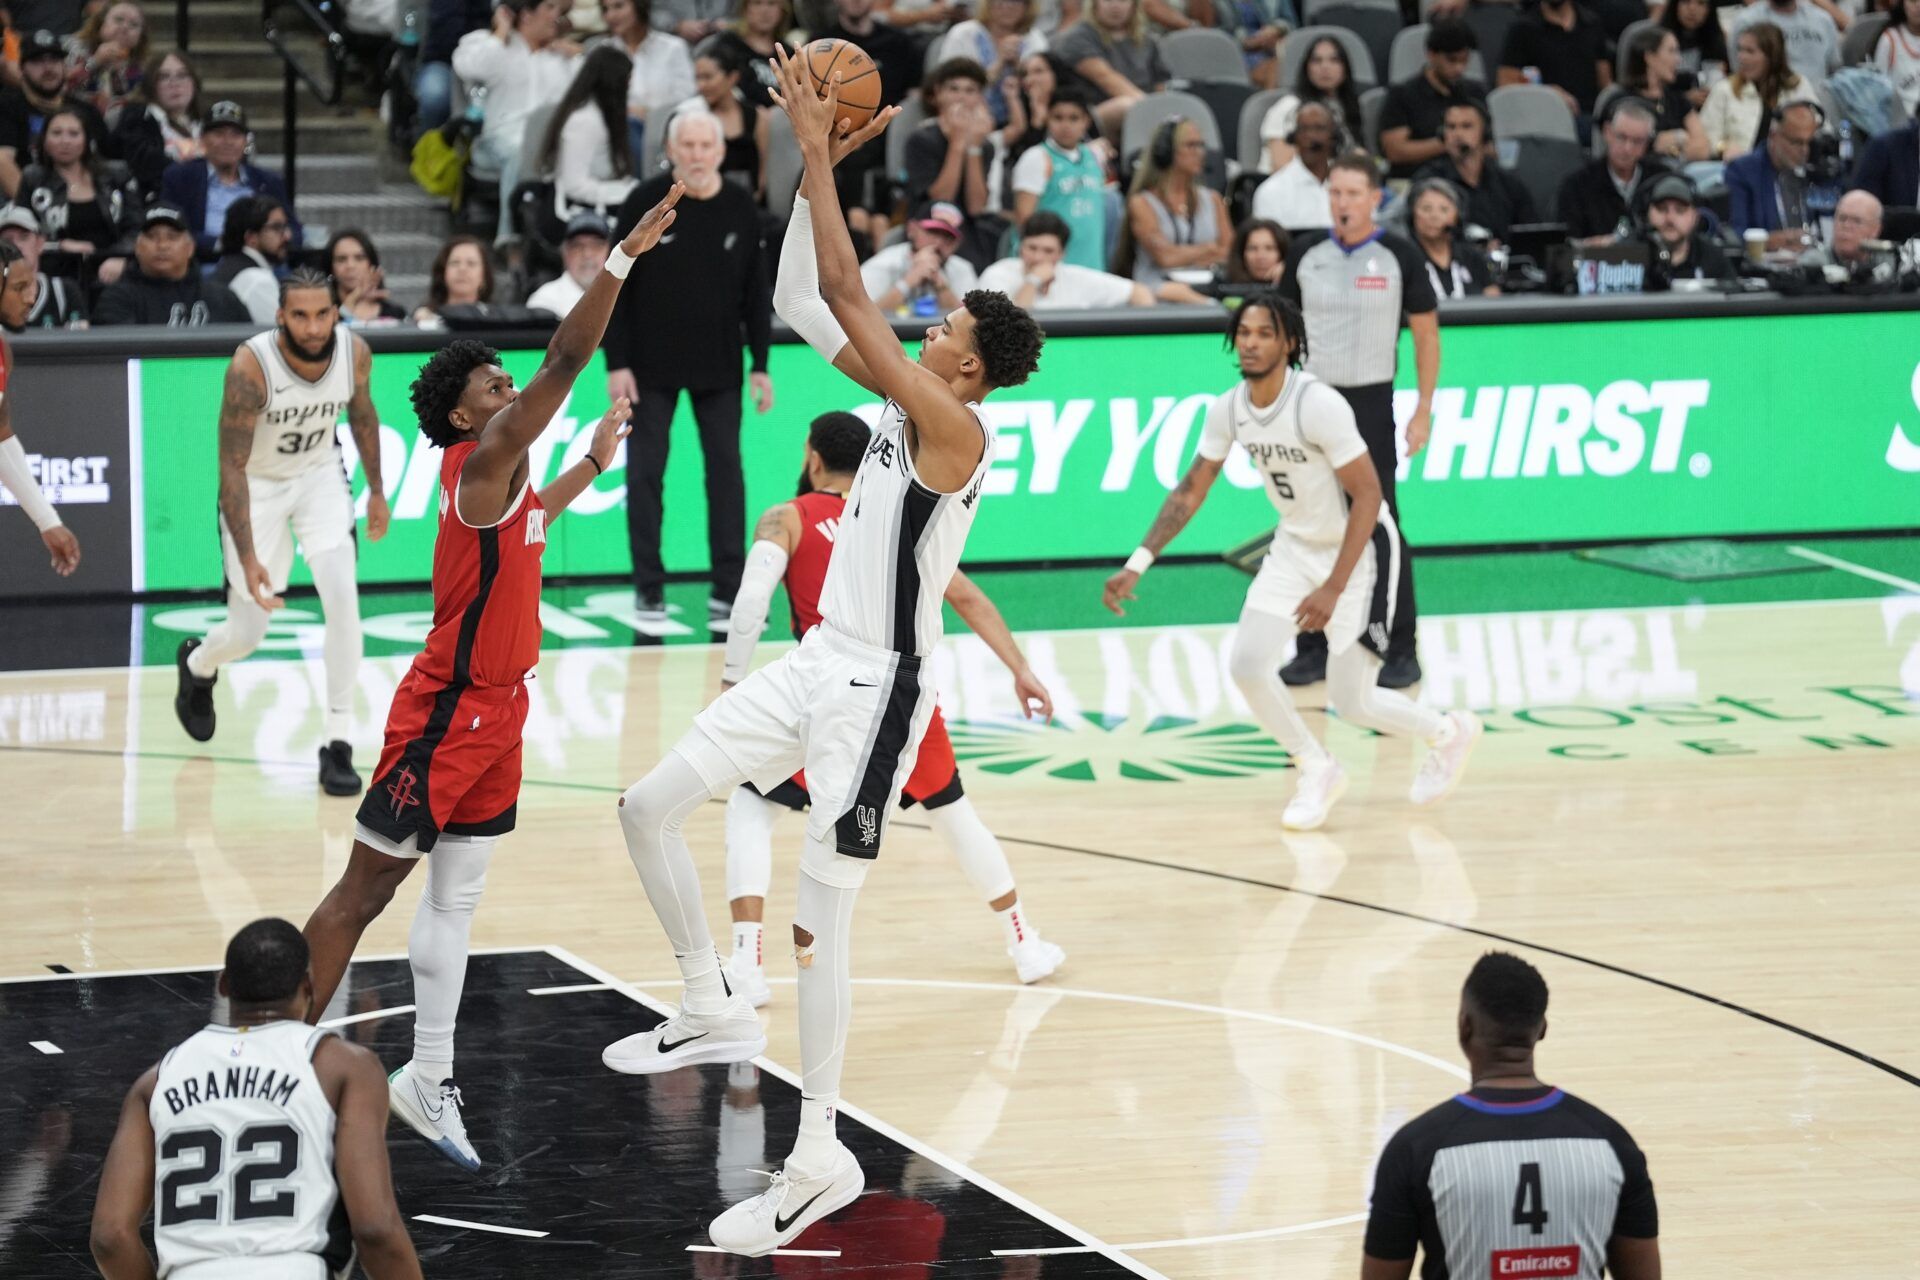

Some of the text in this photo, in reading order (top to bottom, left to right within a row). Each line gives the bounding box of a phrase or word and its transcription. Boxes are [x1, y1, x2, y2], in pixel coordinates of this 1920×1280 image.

[276, 427, 326, 454] 30
[1270, 471, 1295, 500] 5
[163, 1065, 300, 1116] BRANHAM
[157, 1119, 304, 1228] 22
[1512, 1162, 1548, 1235] 4
[1499, 1254, 1572, 1274] Emirates
